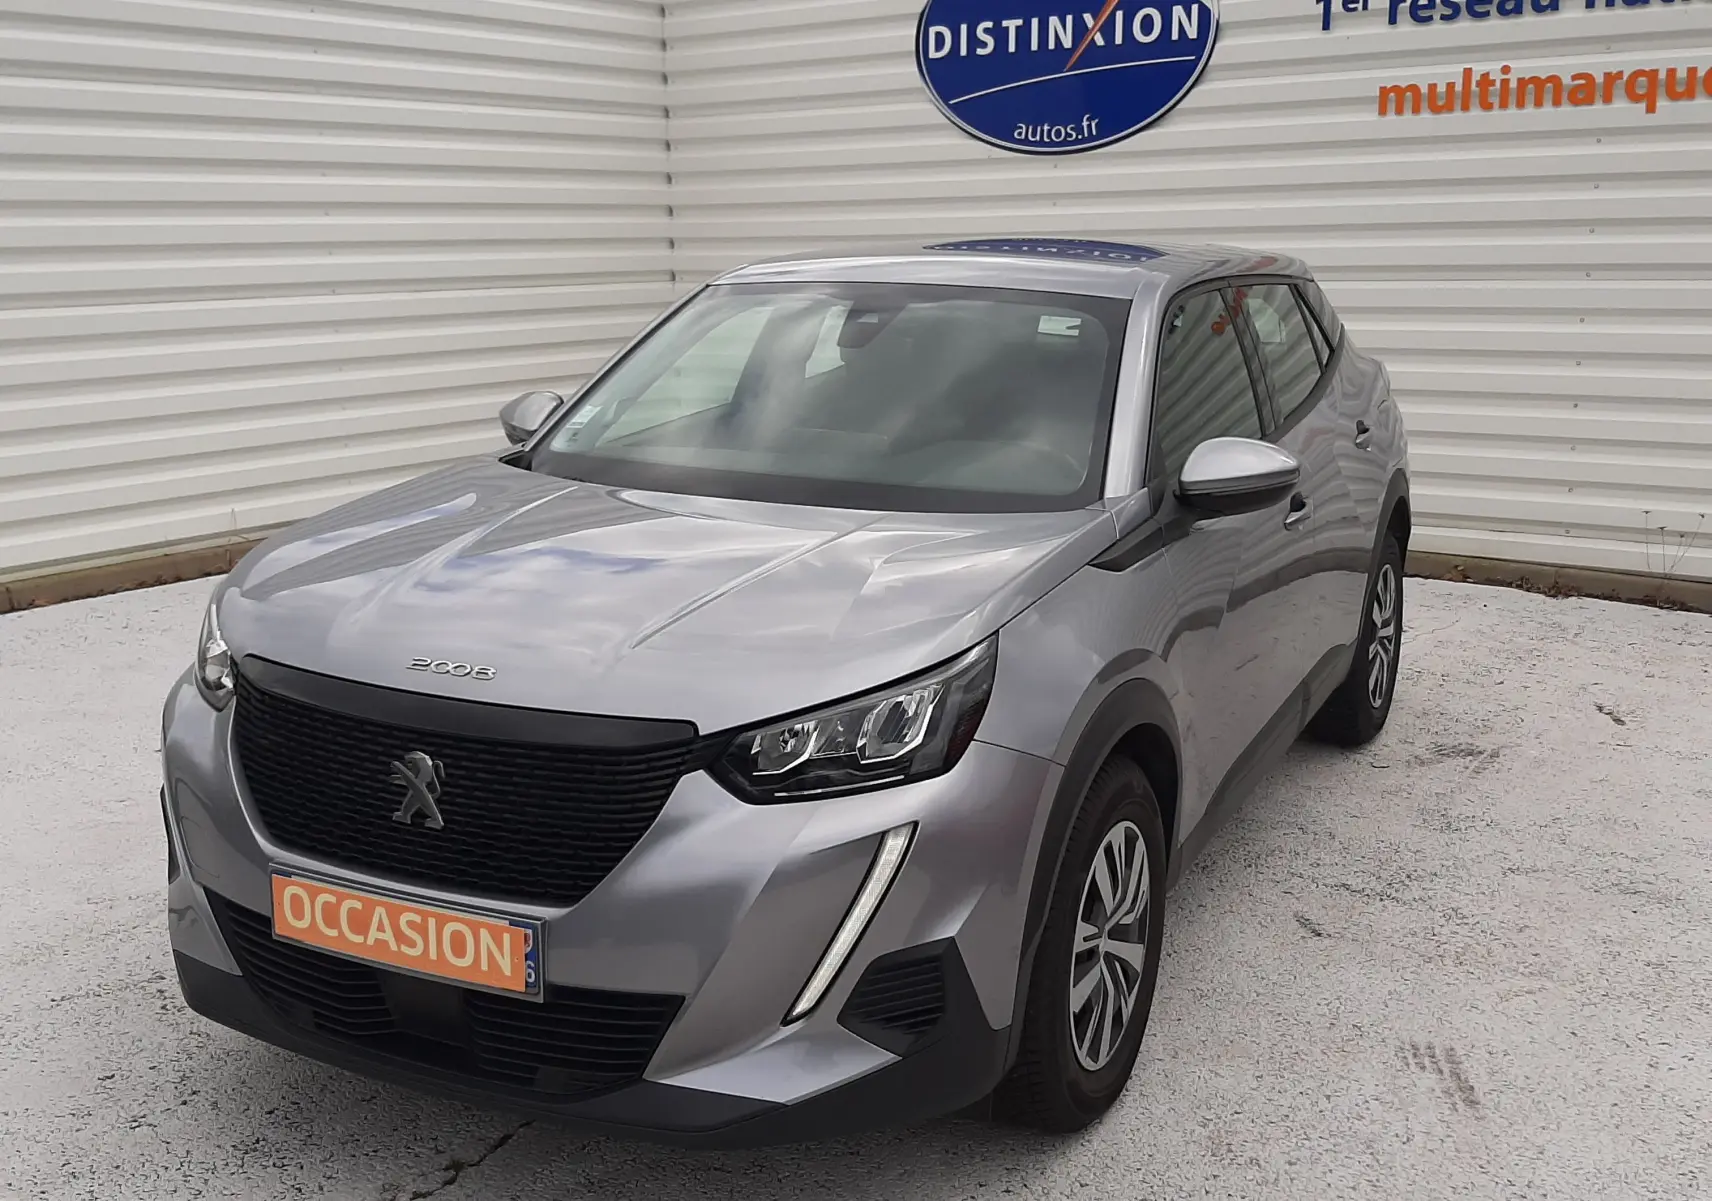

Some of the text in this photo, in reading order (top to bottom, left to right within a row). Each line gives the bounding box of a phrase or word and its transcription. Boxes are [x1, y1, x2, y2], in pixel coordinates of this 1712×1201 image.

[928, 0, 1199, 60] DISTINXION
[1013, 114, 1099, 142] autos.fr
[405, 656, 497, 681] 2008
[283, 885, 512, 977] OCCASION
